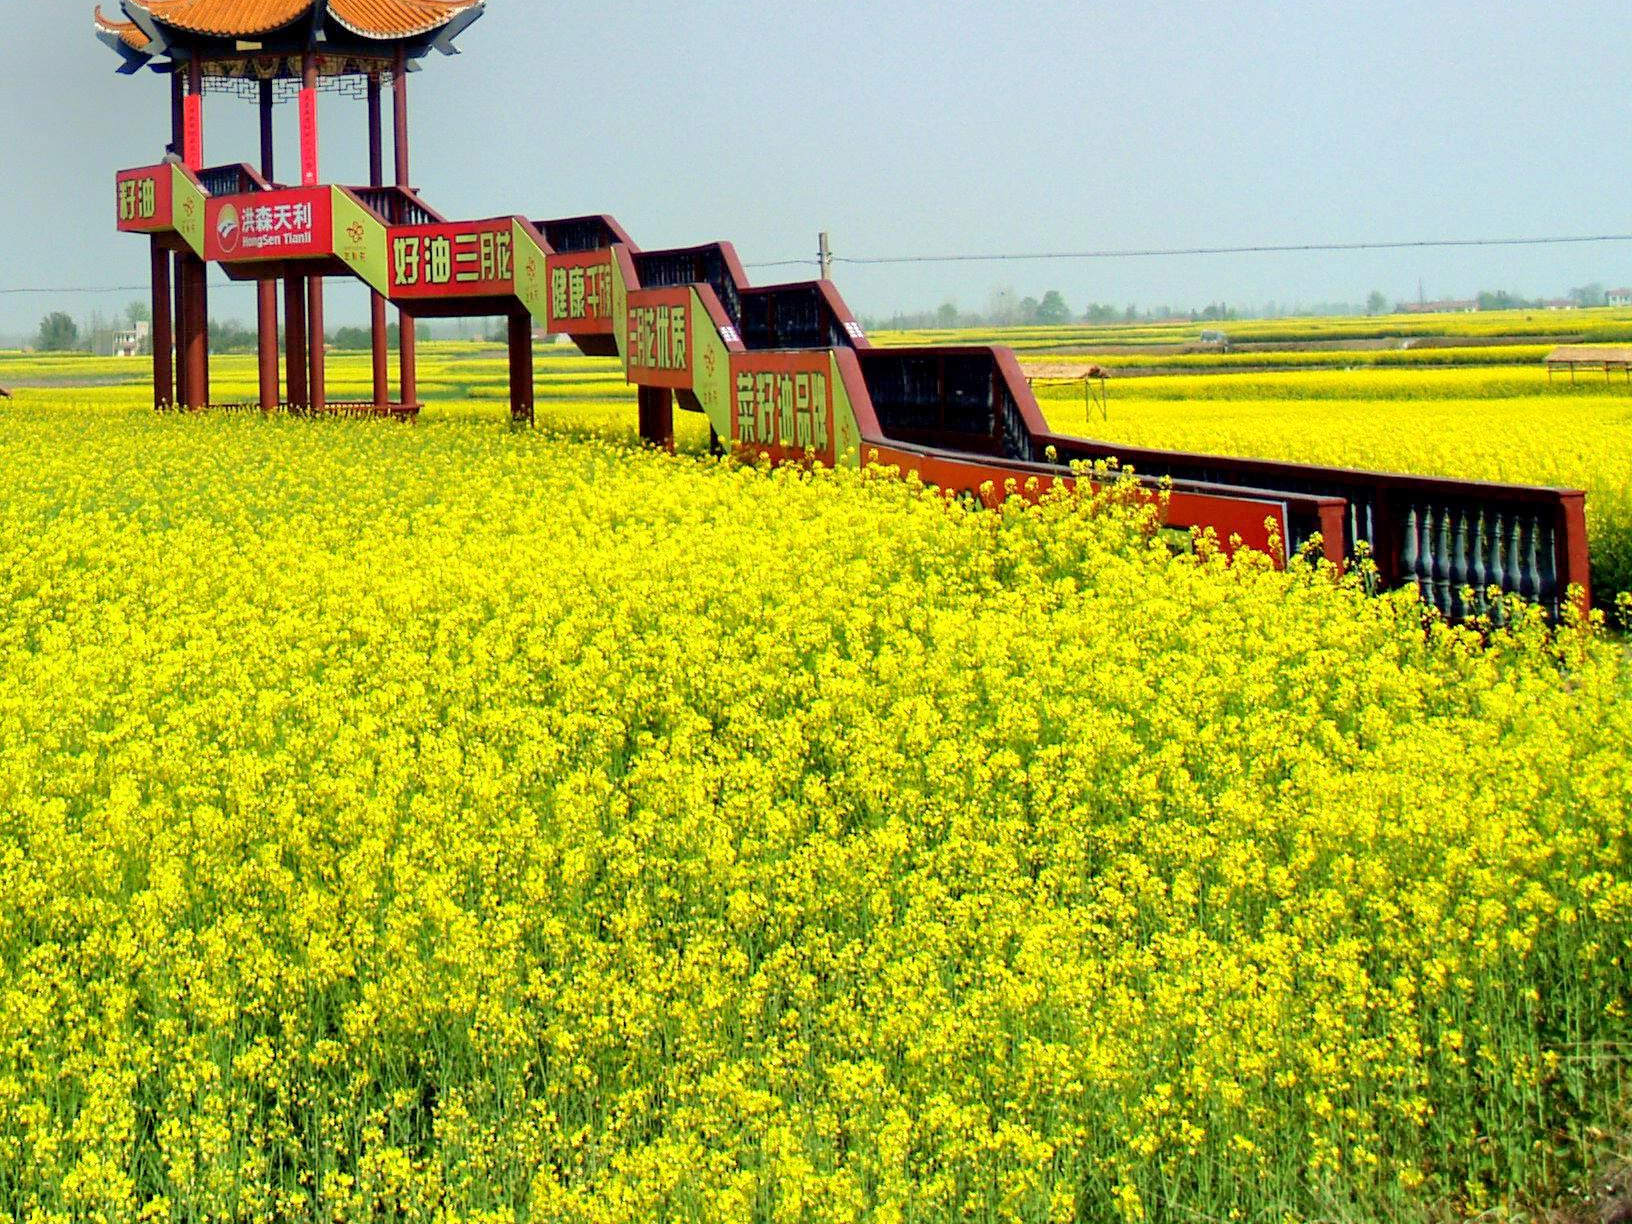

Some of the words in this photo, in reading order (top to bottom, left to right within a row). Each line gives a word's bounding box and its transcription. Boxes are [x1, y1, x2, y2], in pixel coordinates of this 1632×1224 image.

[241, 202, 312, 232] 洪森天利
[242, 234, 281, 248] HongSen
[284, 232, 312, 245] Tianli
[393, 231, 513, 285] 好油三月花
[736, 372, 828, 451] 菜籽油品牌
